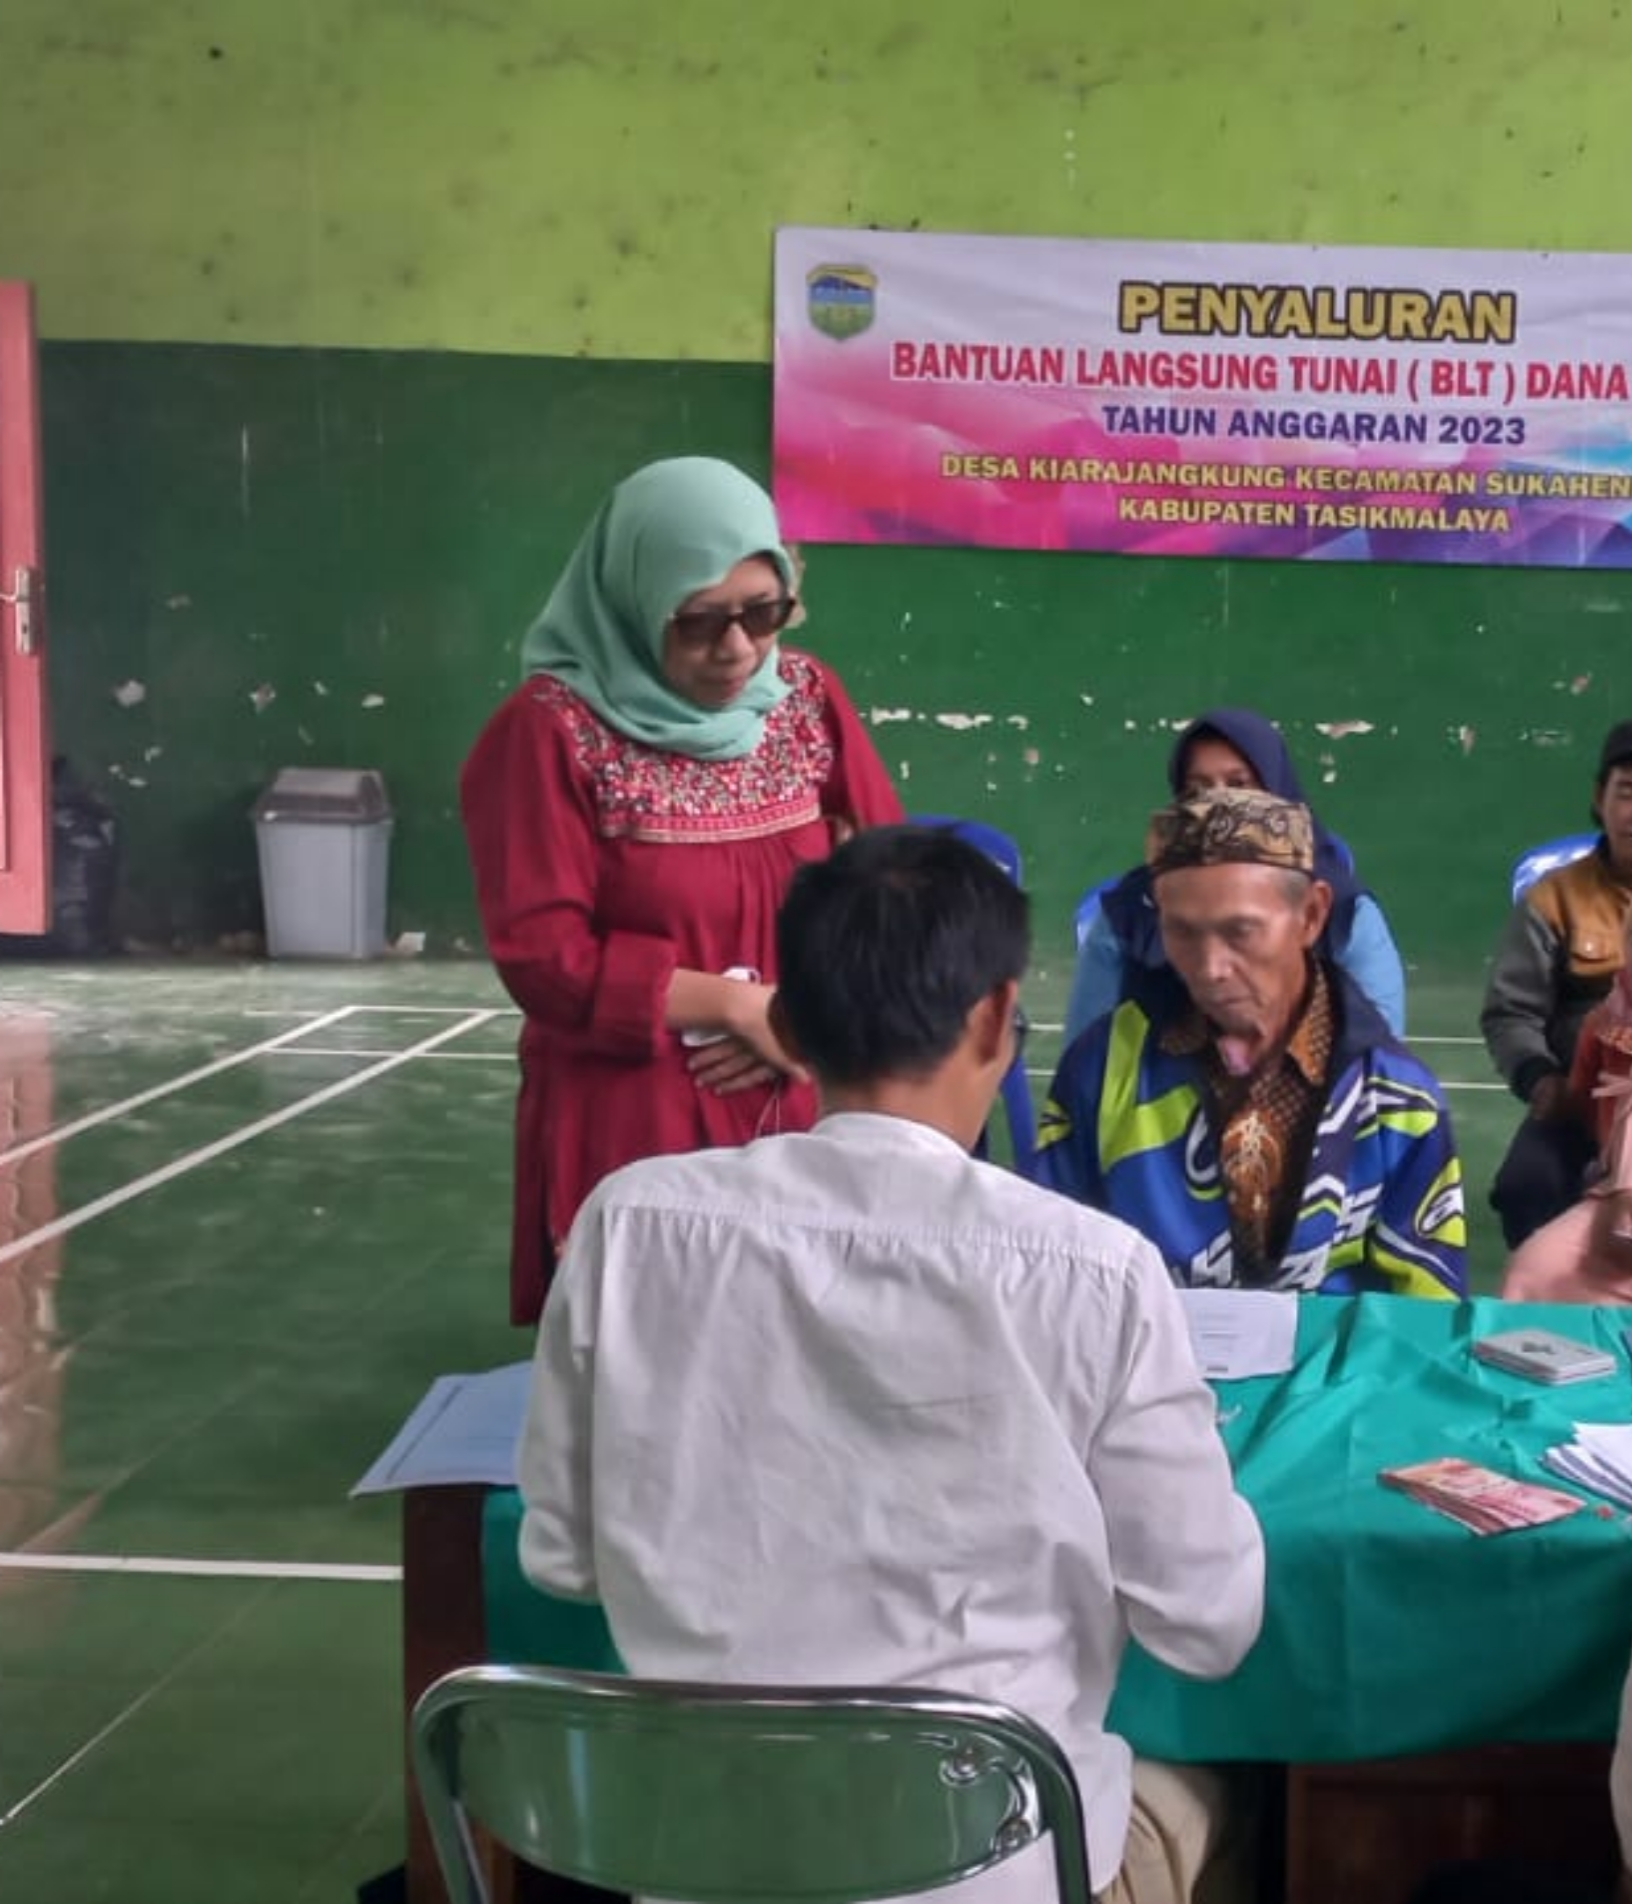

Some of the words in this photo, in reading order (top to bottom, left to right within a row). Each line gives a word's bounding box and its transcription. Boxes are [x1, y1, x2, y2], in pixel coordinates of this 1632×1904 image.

[1119, 281, 1516, 343] PENYALURAN
[893, 342, 1064, 384] BANTUAN
[1076, 349, 1277, 389] LANGSUNG
[1288, 355, 1397, 395] TUNAI
[1430, 360, 1494, 397] BLT
[1526, 362, 1628, 401] DANA
[1103, 405, 1216, 437] TAHUN
[1227, 409, 1428, 443] ANGGARAN
[1438, 415, 1526, 445] 2023
[942, 454, 1019, 480] DESA
[1029, 457, 1284, 489] KIARAJANGKUNG
[1296, 465, 1477, 495] KECAMATAN
[1119, 498, 1295, 527] KABUPATEN
[1304, 502, 1510, 533] TASIKMALAYA
